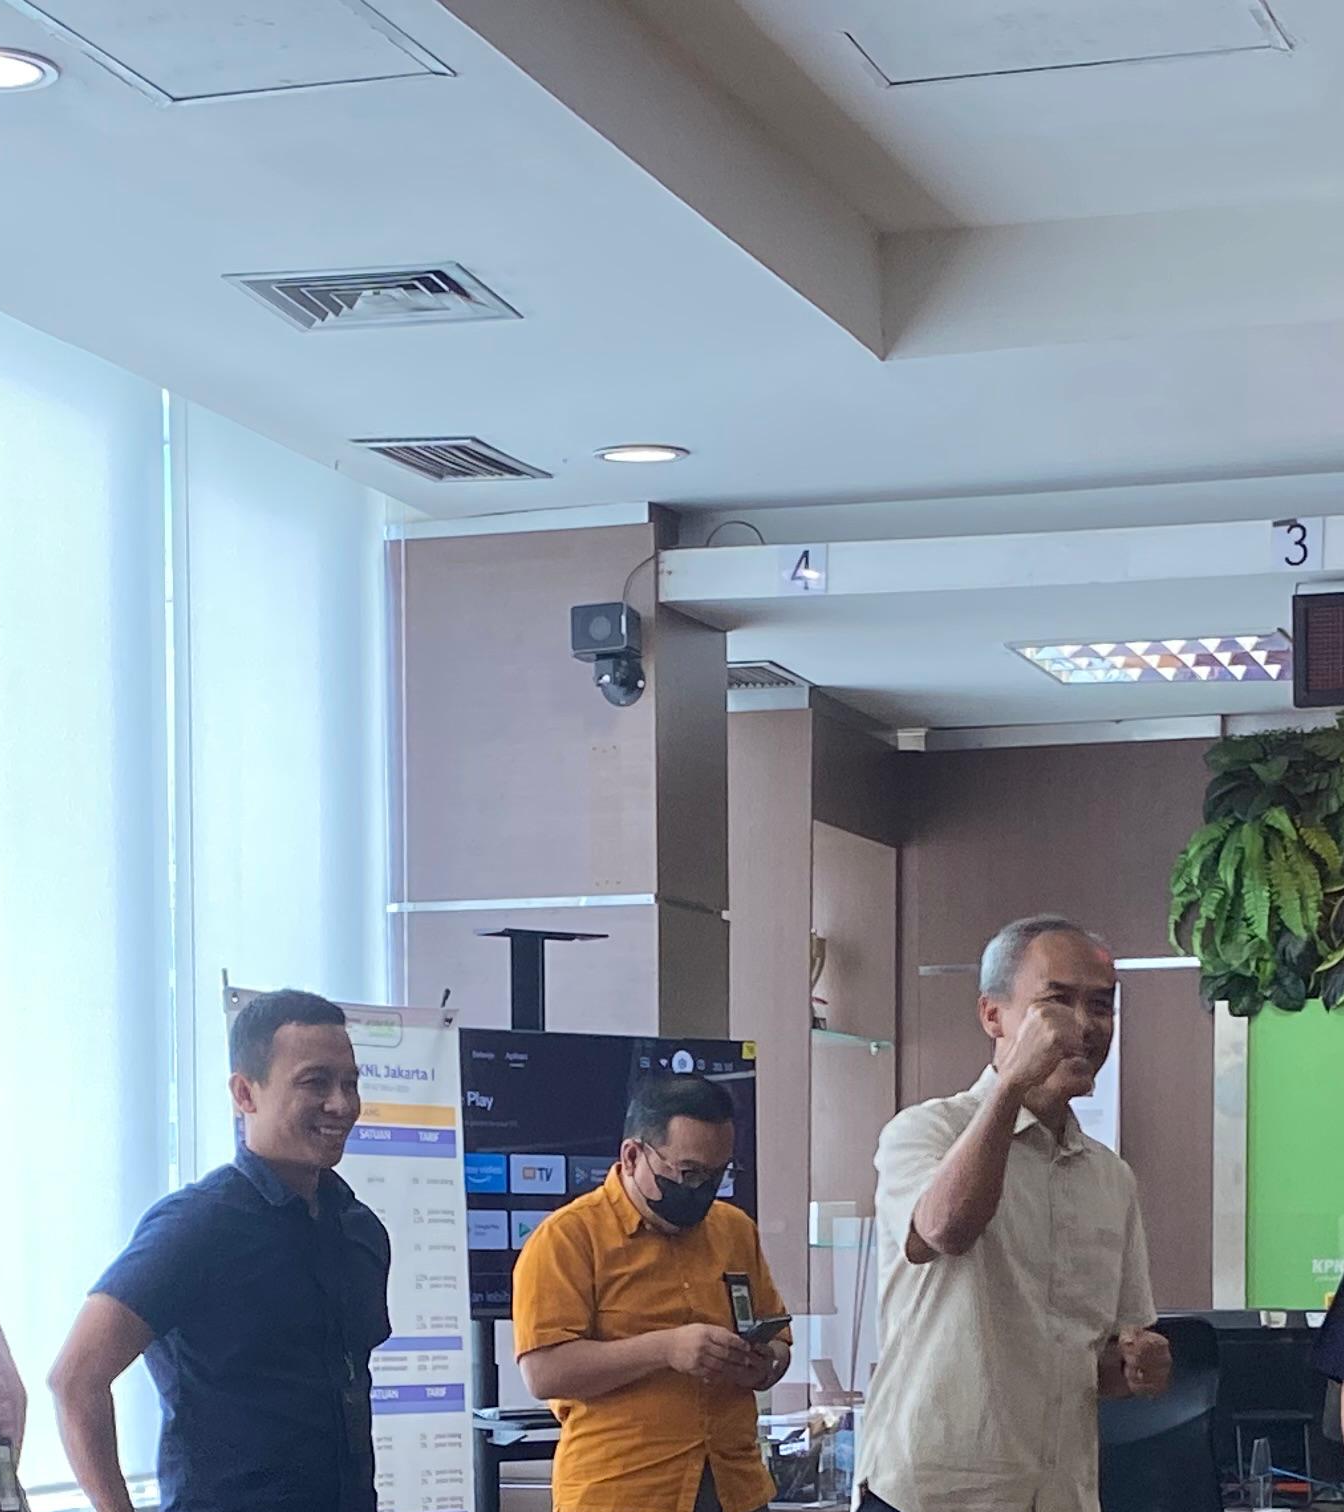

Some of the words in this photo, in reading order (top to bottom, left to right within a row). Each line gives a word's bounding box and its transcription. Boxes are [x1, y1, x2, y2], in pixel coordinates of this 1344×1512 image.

[1284, 522, 1309, 567] 3
[384, 1065, 428, 1081] Jakarta
[466, 1090, 494, 1111] Play
